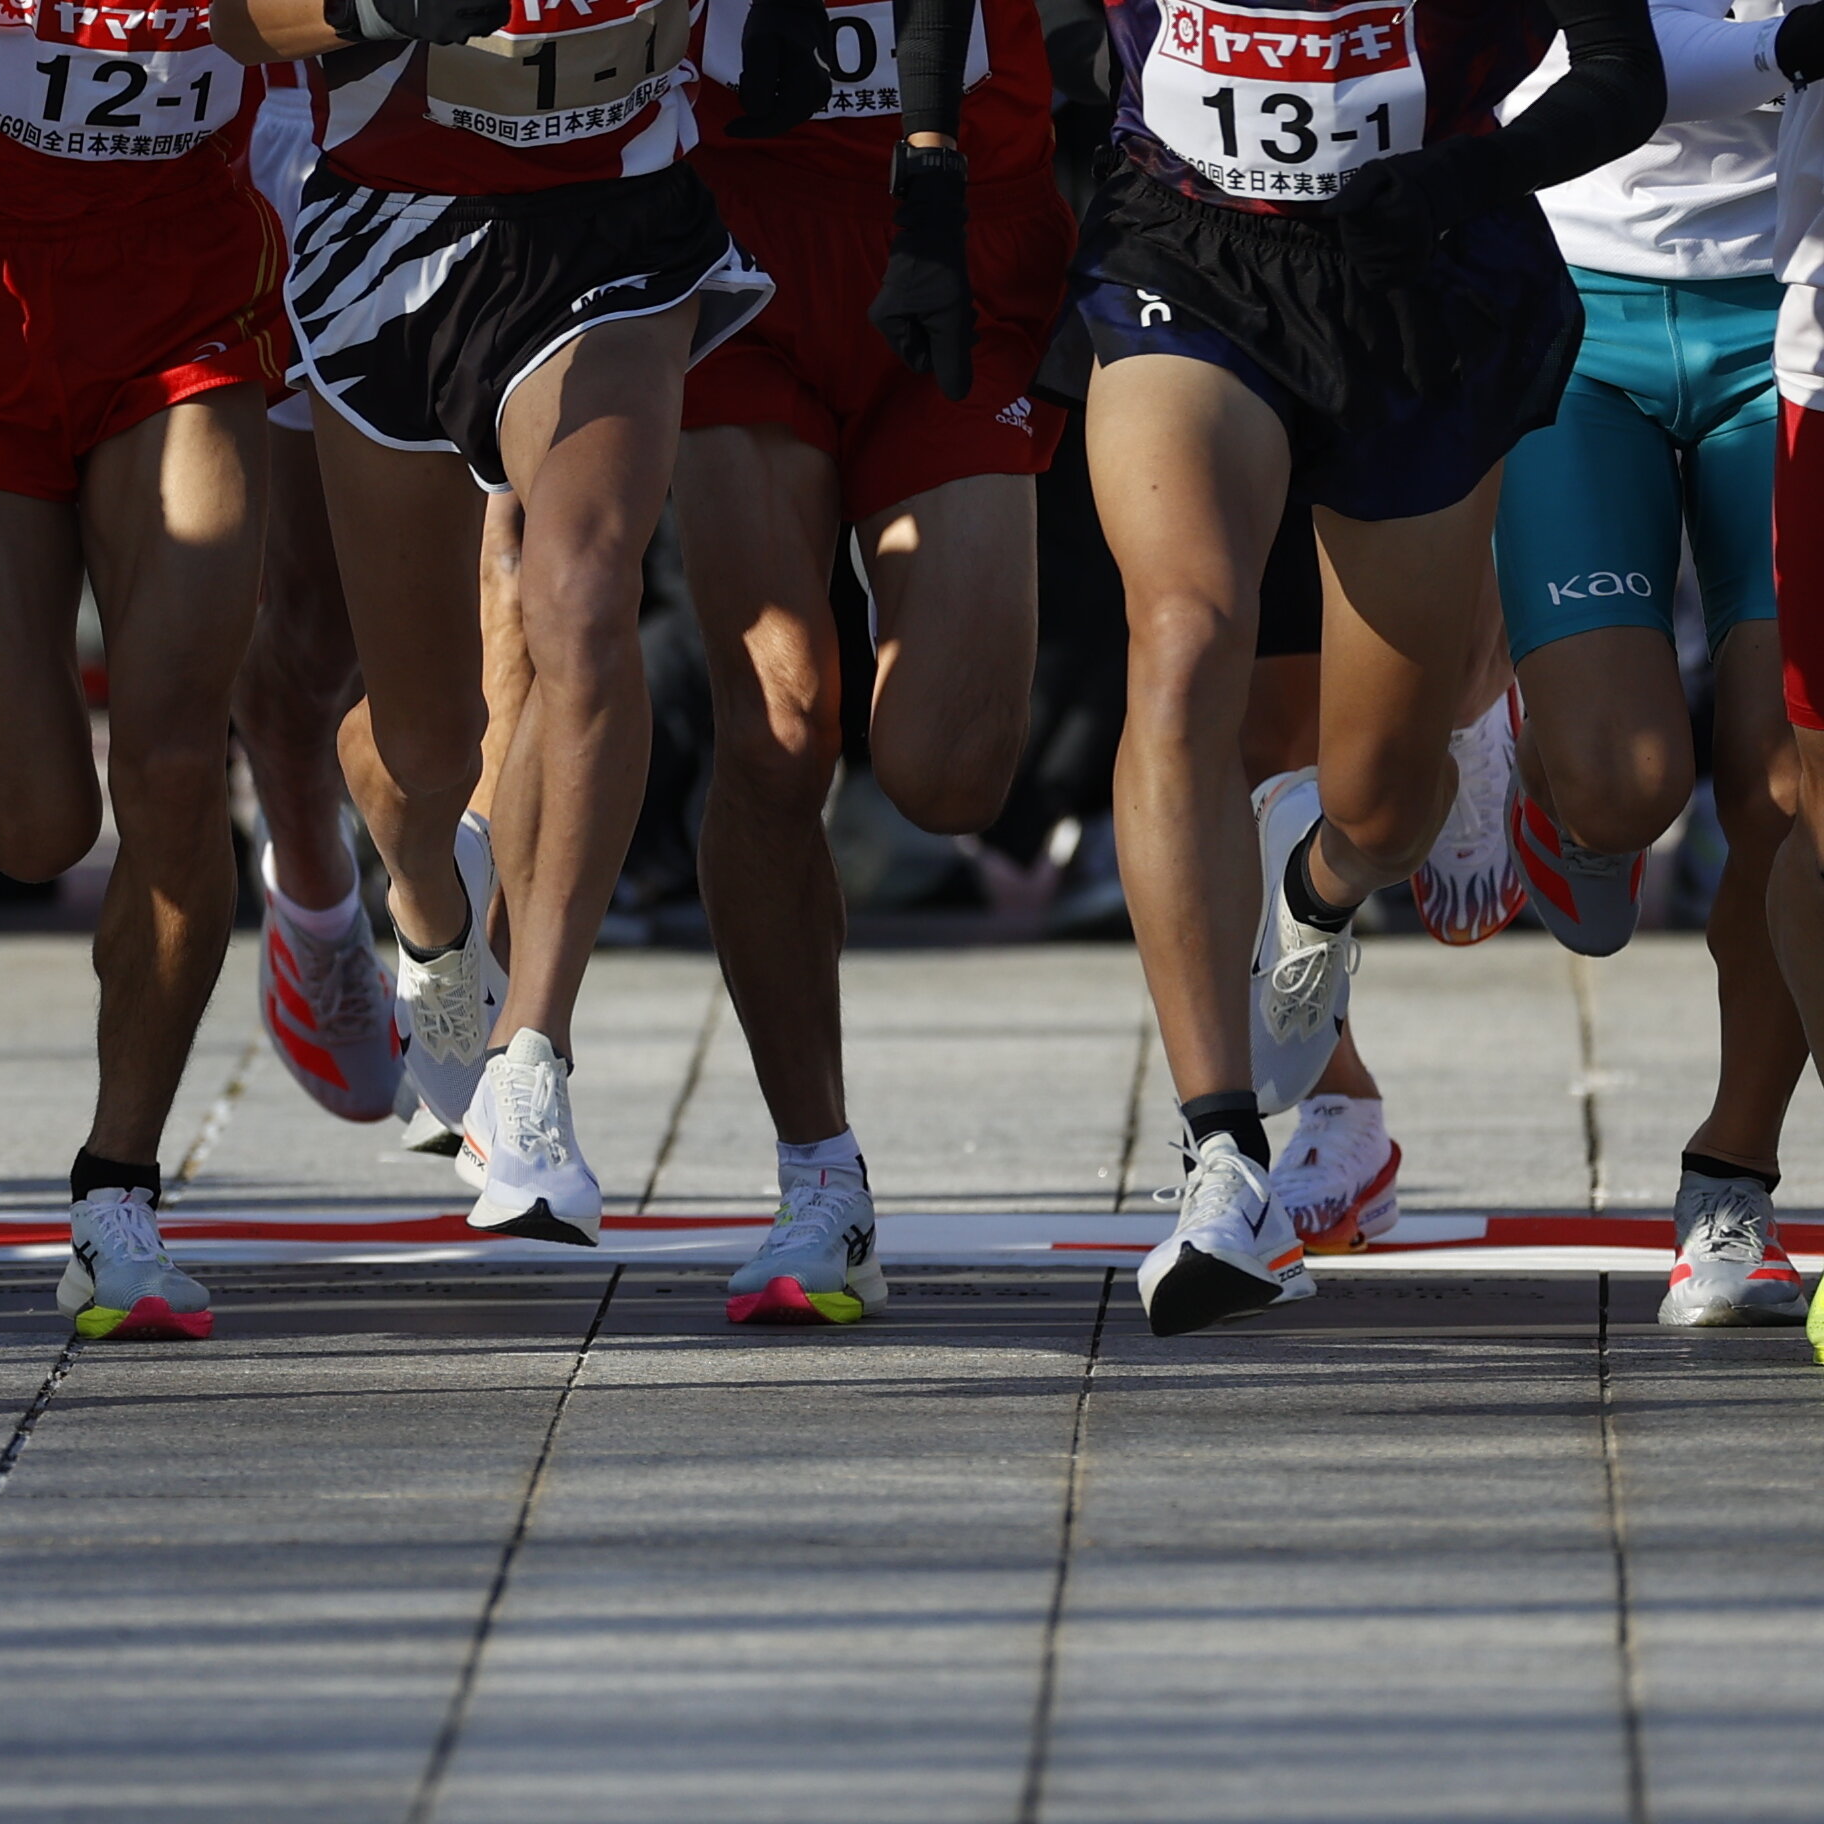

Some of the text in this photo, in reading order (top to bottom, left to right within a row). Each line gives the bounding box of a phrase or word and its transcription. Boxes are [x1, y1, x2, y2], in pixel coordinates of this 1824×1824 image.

[1208, 23, 1393, 70] ヤマザキ
[35, 54, 213, 128] 12-1
[1201, 87, 1391, 165] 13-1
